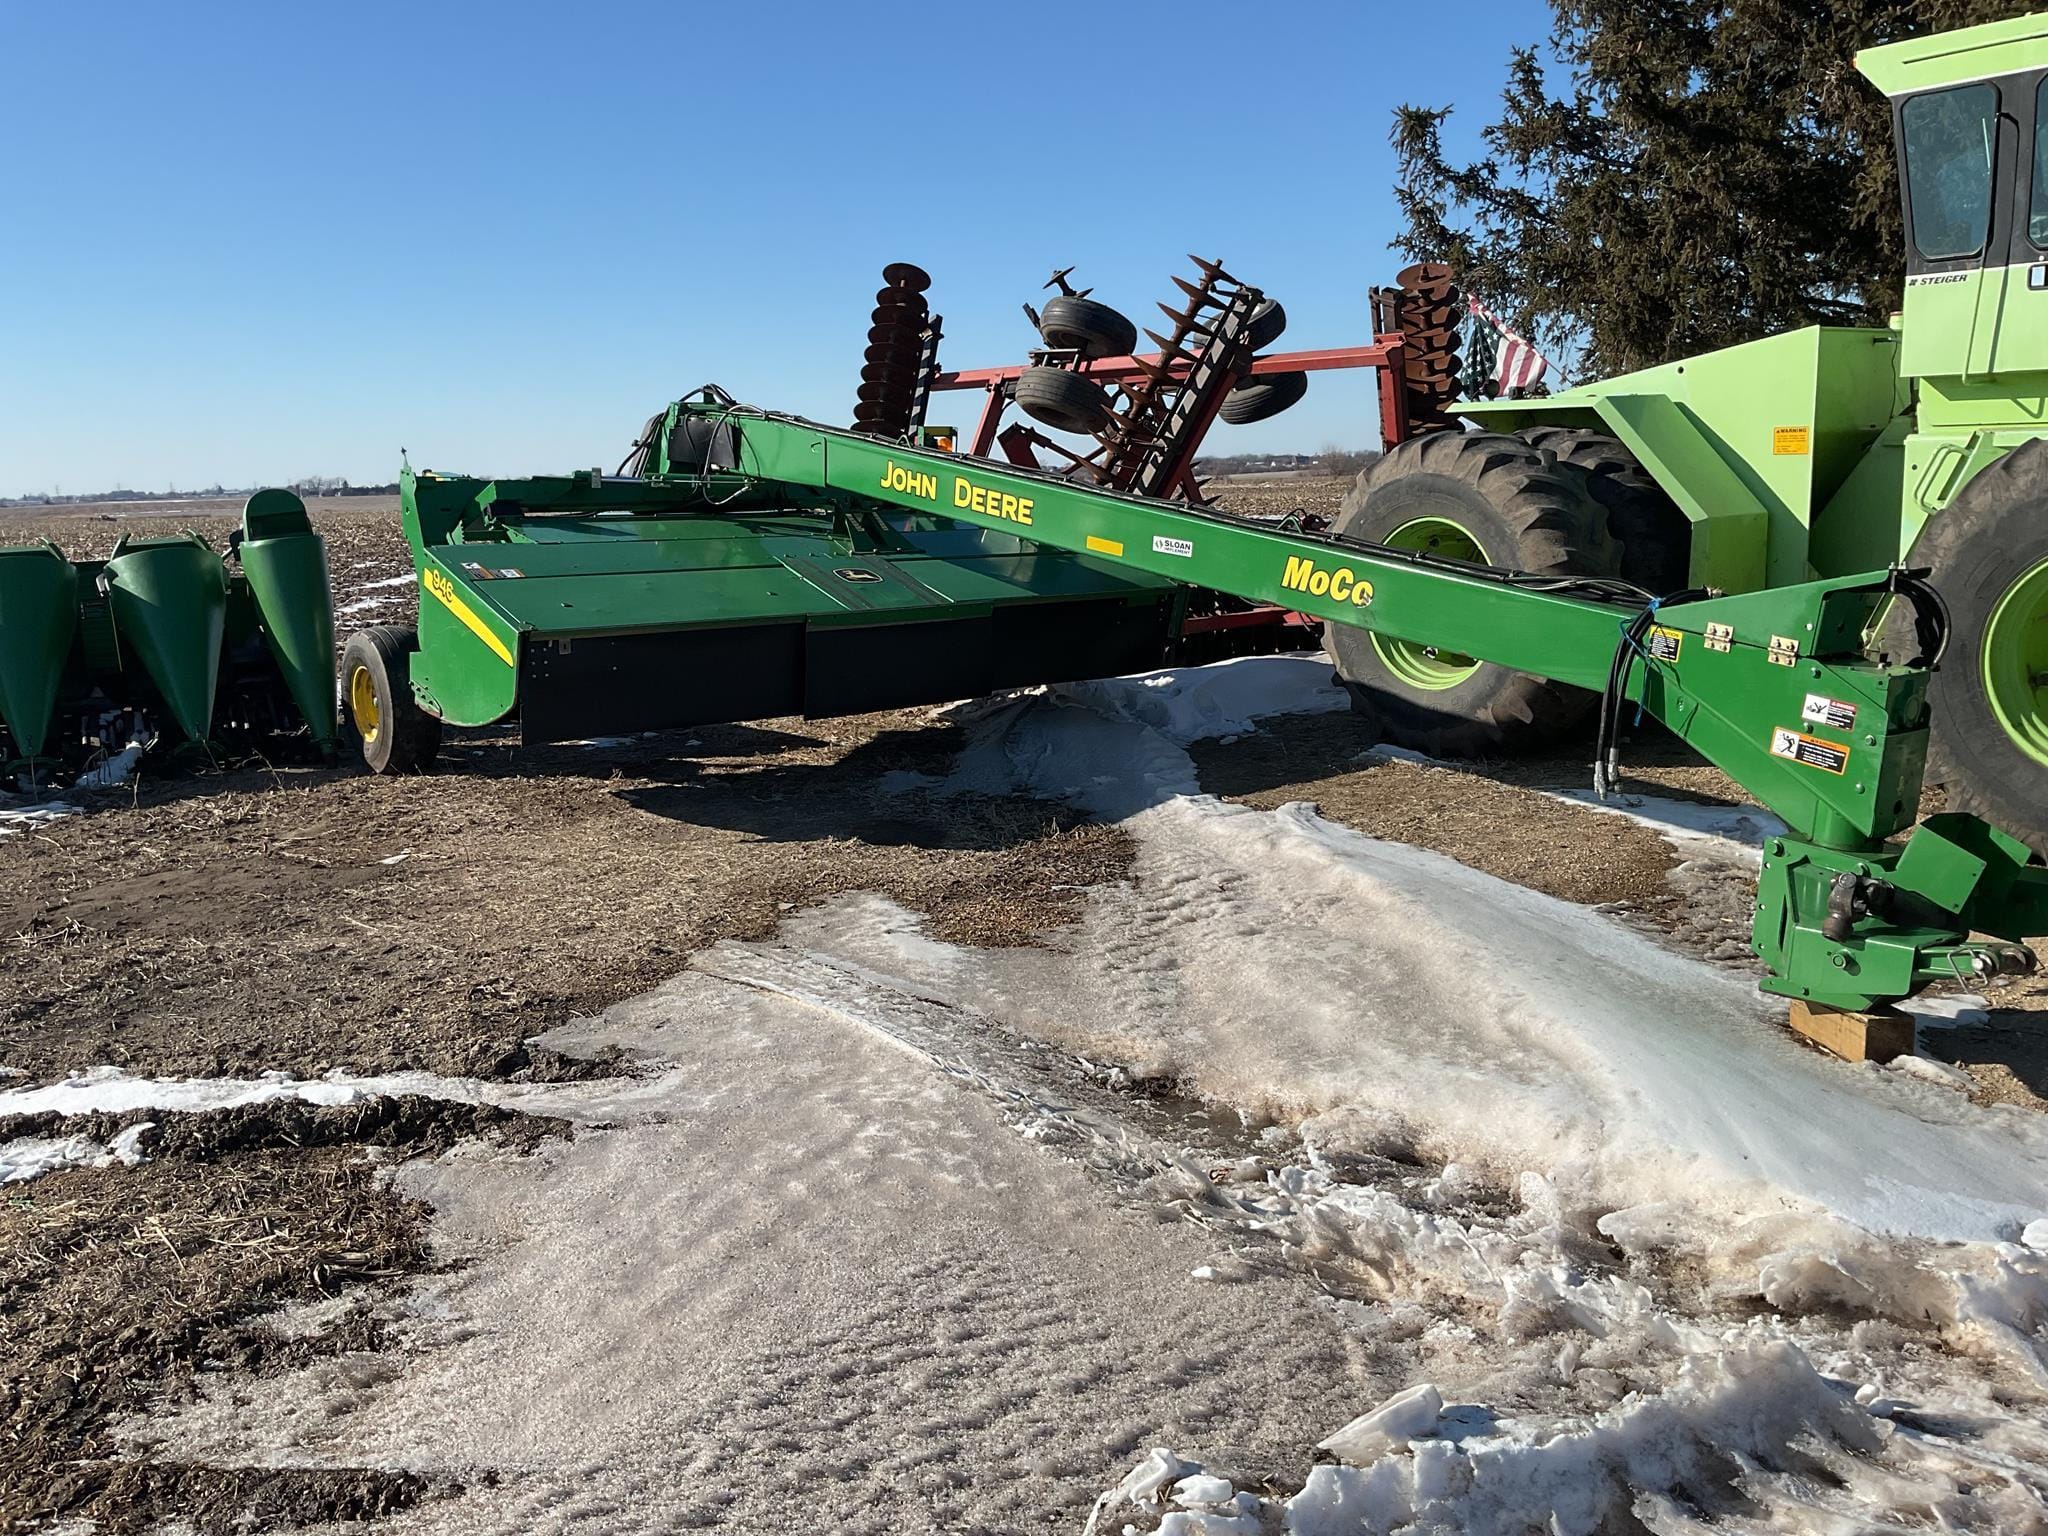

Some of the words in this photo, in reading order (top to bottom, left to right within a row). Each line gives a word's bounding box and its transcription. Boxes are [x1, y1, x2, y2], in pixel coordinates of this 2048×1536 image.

[1920, 275, 1968, 286] STEIGER
[880, 460, 937, 501] JOHN
[953, 477, 1034, 526] DEERE
[1164, 540, 1191, 550] SLOAN
[432, 569, 454, 603] 946
[1281, 555, 1374, 608] MoCo
